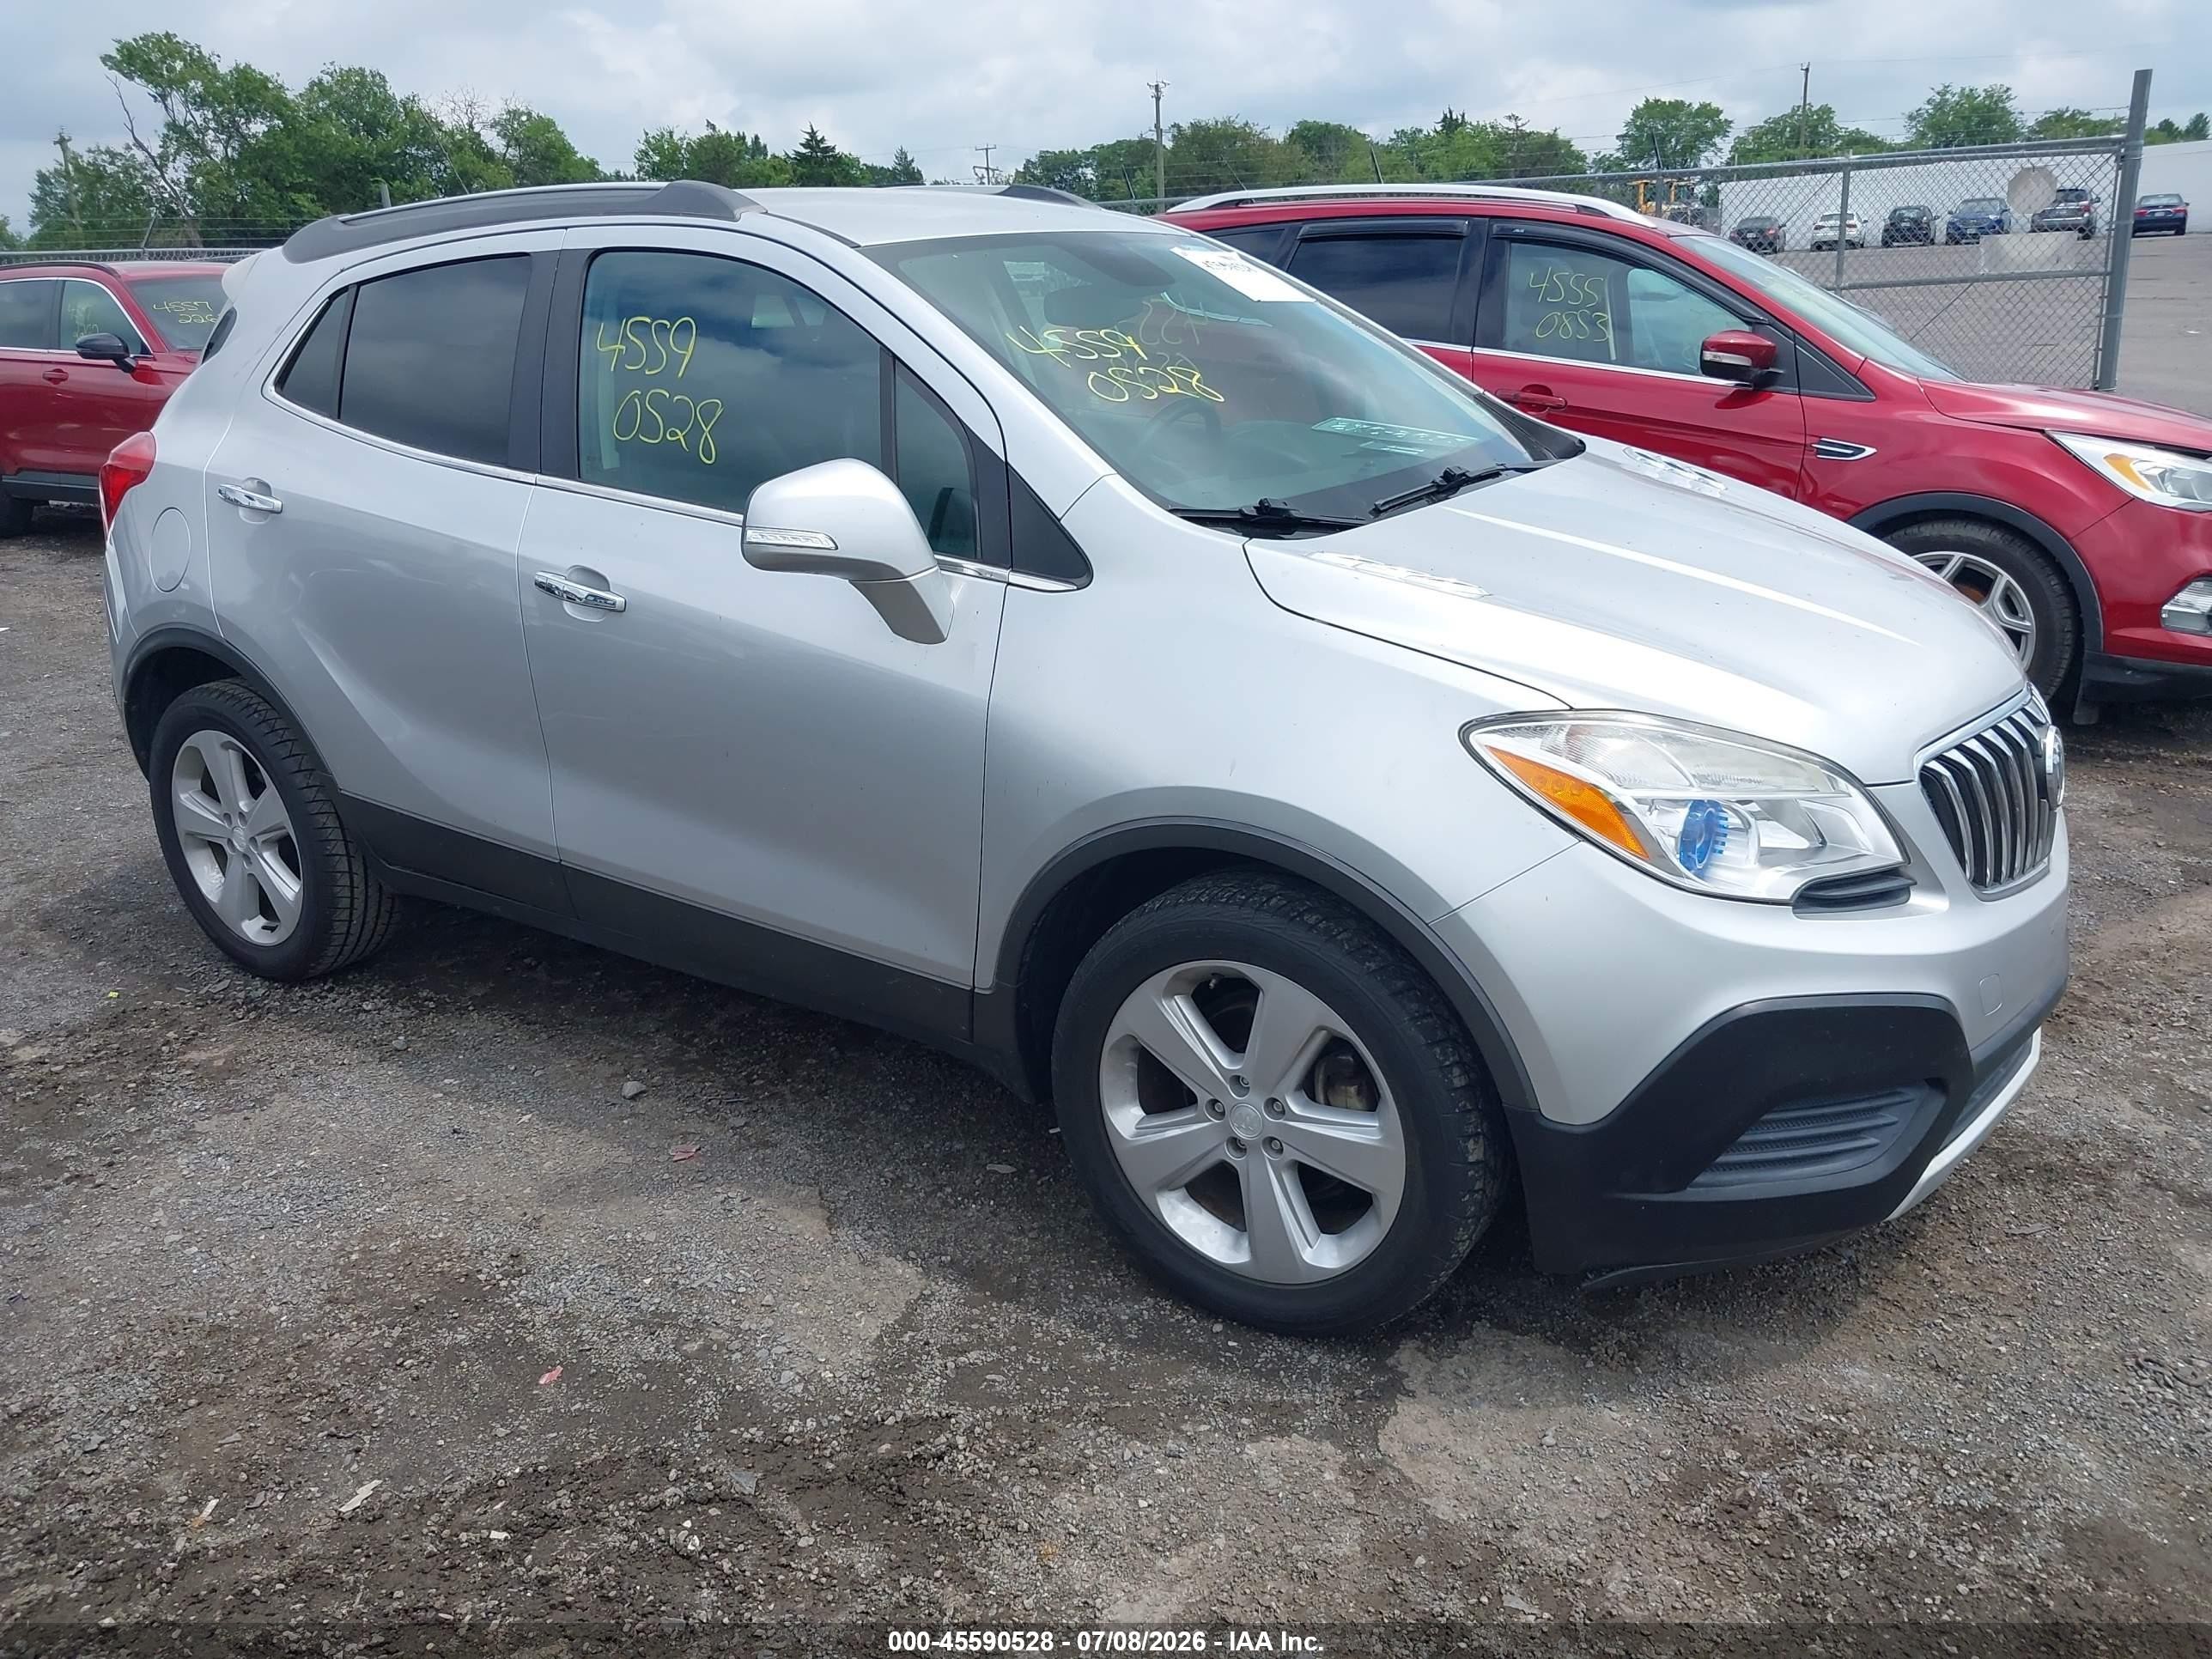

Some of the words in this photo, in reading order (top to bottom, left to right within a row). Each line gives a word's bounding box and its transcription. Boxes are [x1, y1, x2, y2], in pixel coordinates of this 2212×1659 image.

[153, 301, 213, 313] 4557
[1528, 266, 1604, 307] 4555
[1535, 309, 1609, 342] 0853
[597, 316, 697, 378] 4559
[1005, 325, 1148, 369] 4559
[1086, 365, 1226, 403] 0528
[613, 388, 725, 465] 0528
